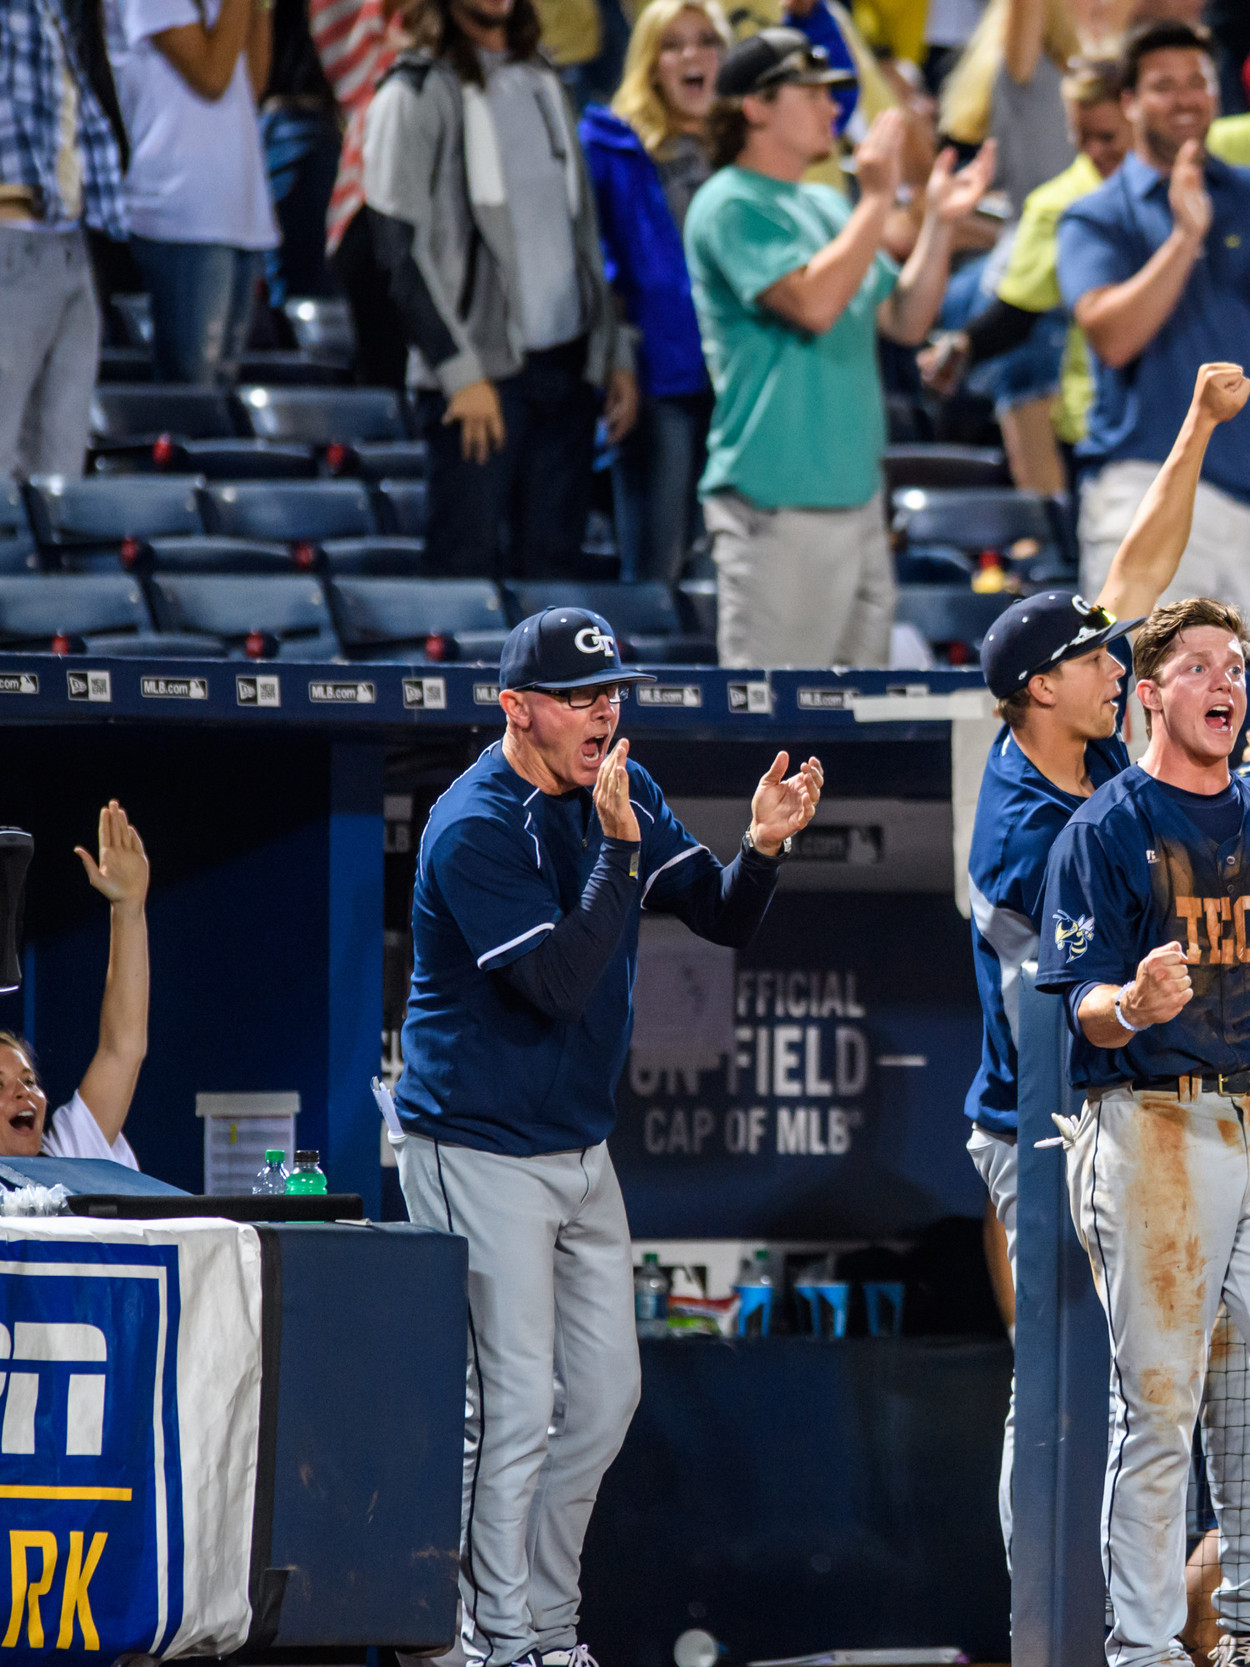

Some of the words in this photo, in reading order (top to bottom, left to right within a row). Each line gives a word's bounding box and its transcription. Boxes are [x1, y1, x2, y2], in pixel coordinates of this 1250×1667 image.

[143, 680, 188, 695] MLB.com
[311, 685, 356, 700] MLB.com
[736, 971, 866, 1018] FFICIAL
[727, 1026, 869, 1097] FIELD
[645, 1109, 714, 1155] CAP
[725, 1109, 767, 1155] OF
